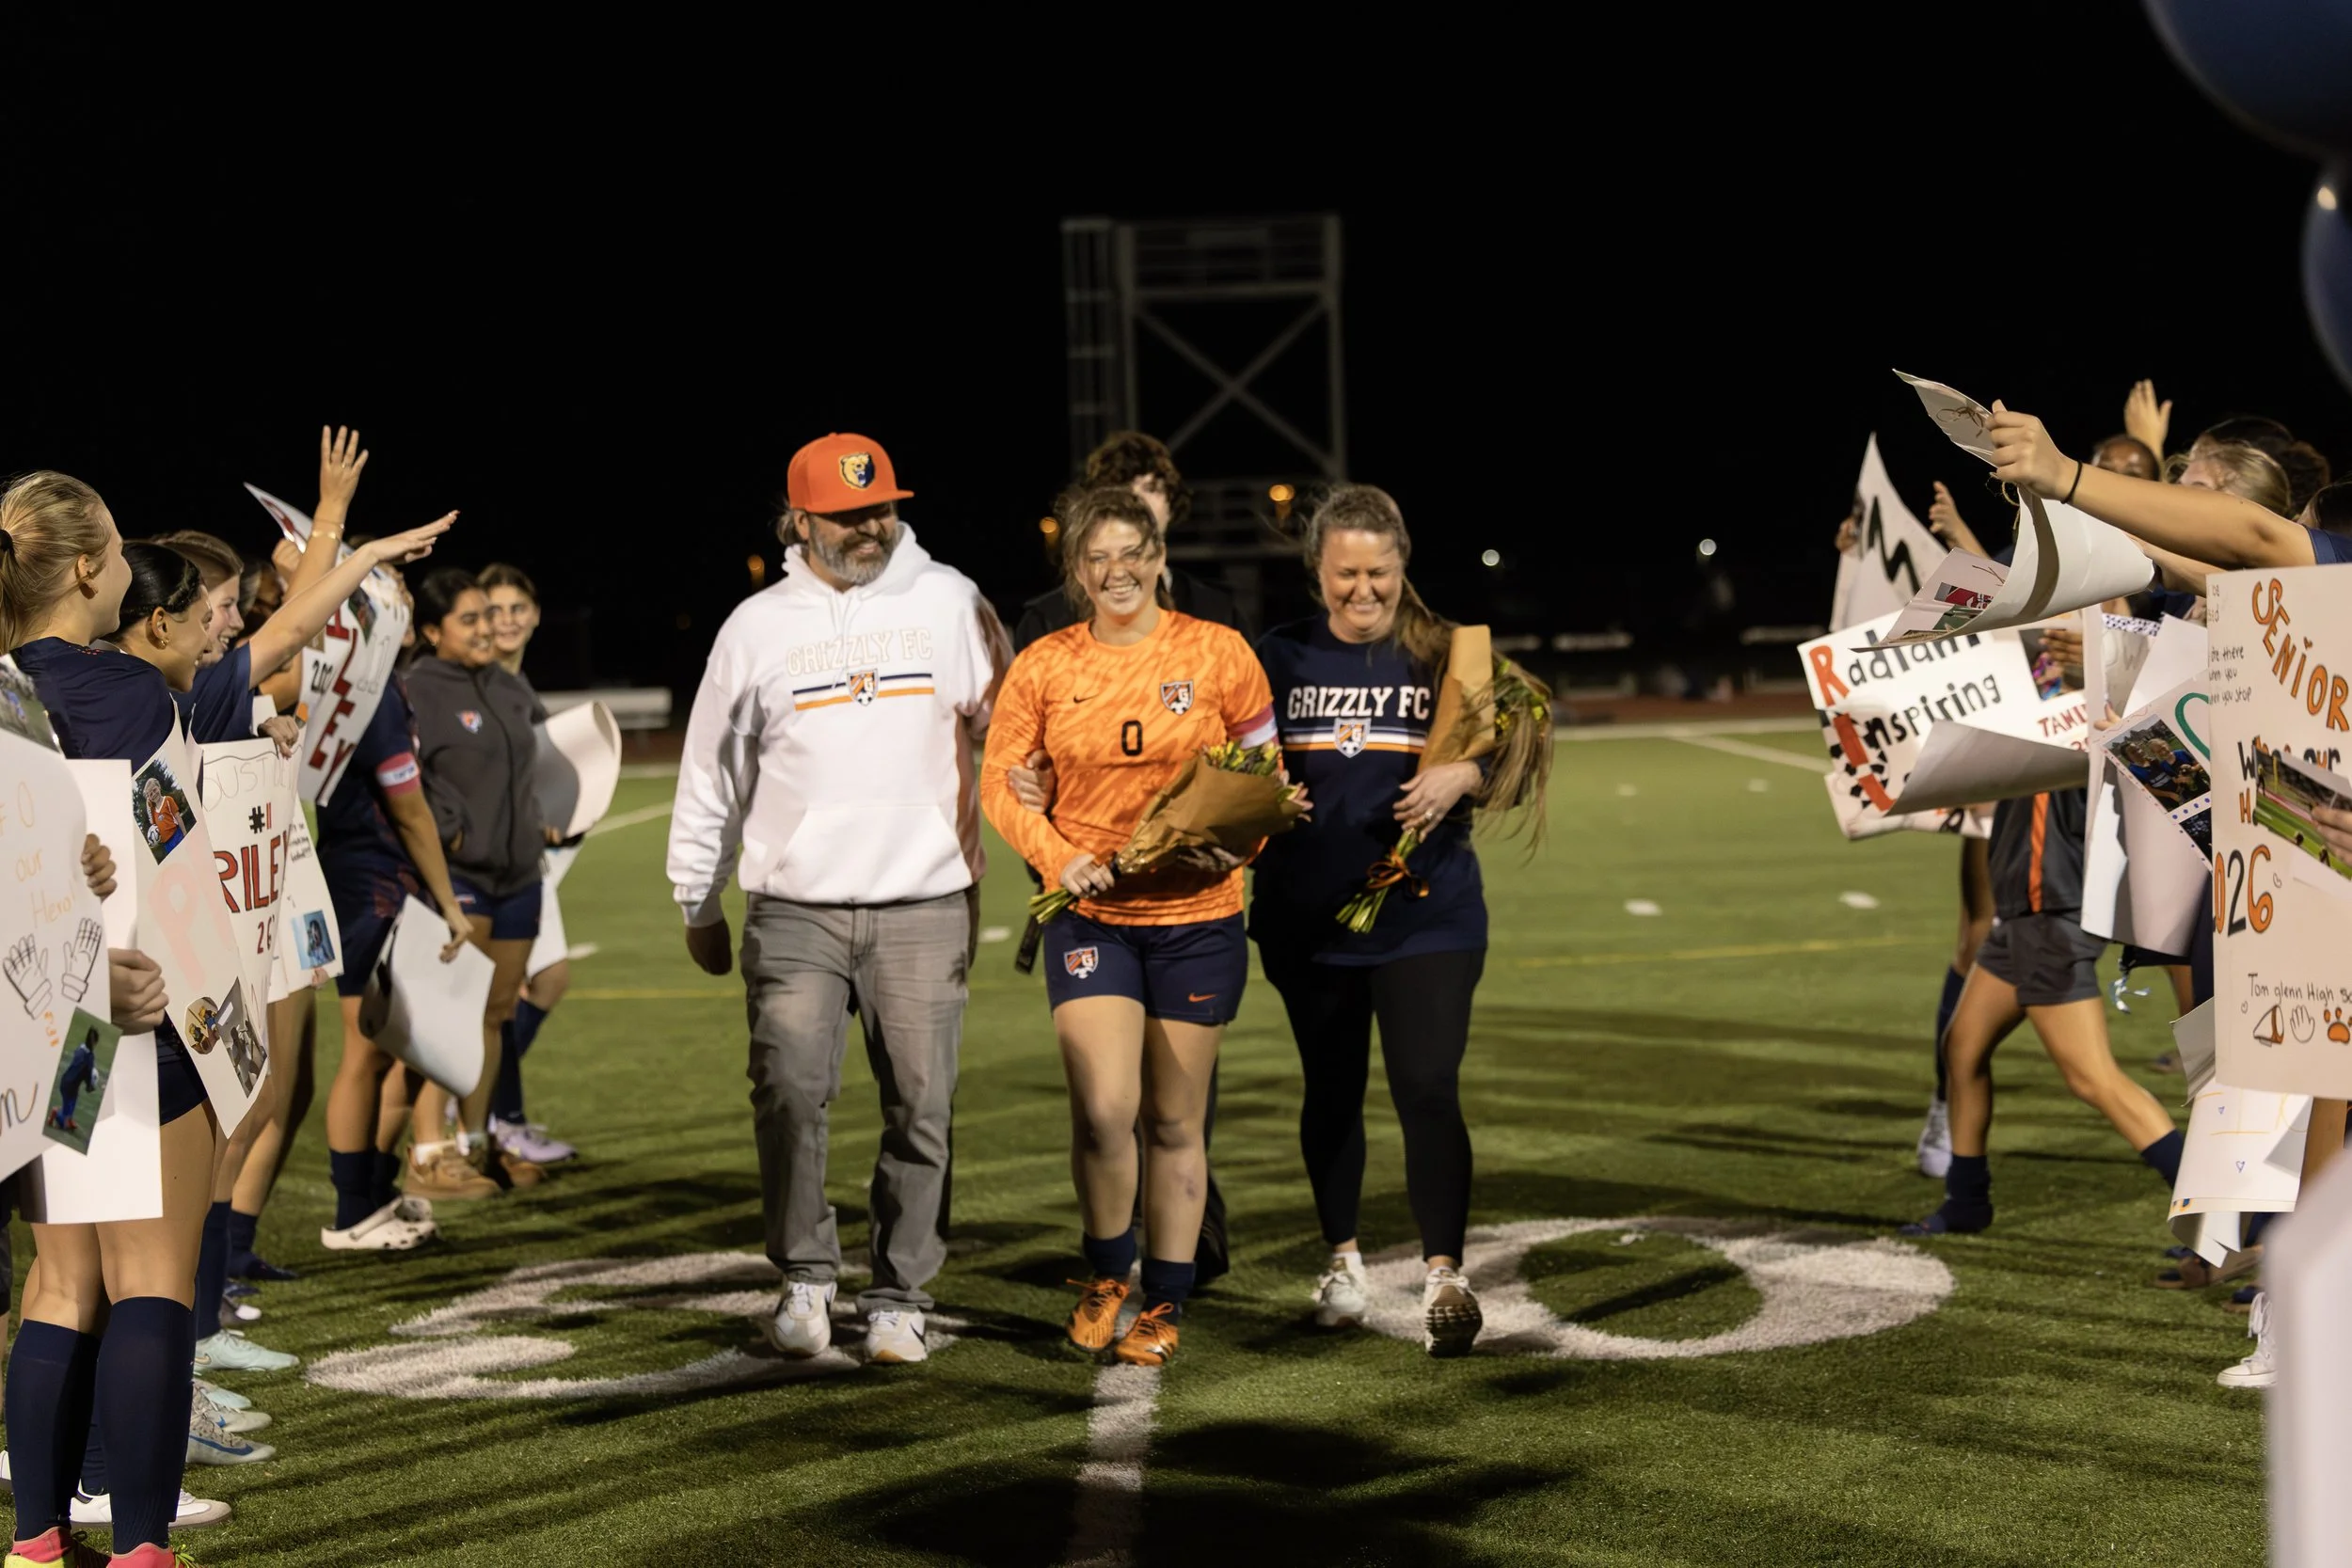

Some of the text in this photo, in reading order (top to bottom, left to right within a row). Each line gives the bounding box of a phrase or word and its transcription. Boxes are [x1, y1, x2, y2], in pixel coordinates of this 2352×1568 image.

[787, 628, 933, 677] GRIZZLY FC
[2252, 578, 2350, 732] SENIOR
[1287, 686, 1431, 721] GRIZZLY FC
[1121, 720, 1143, 757] 0
[2212, 844, 2274, 937] 026
[2248, 973, 2269, 997] Tom
[2275, 980, 2303, 1006] glenn
[2307, 982, 2335, 1007] High
